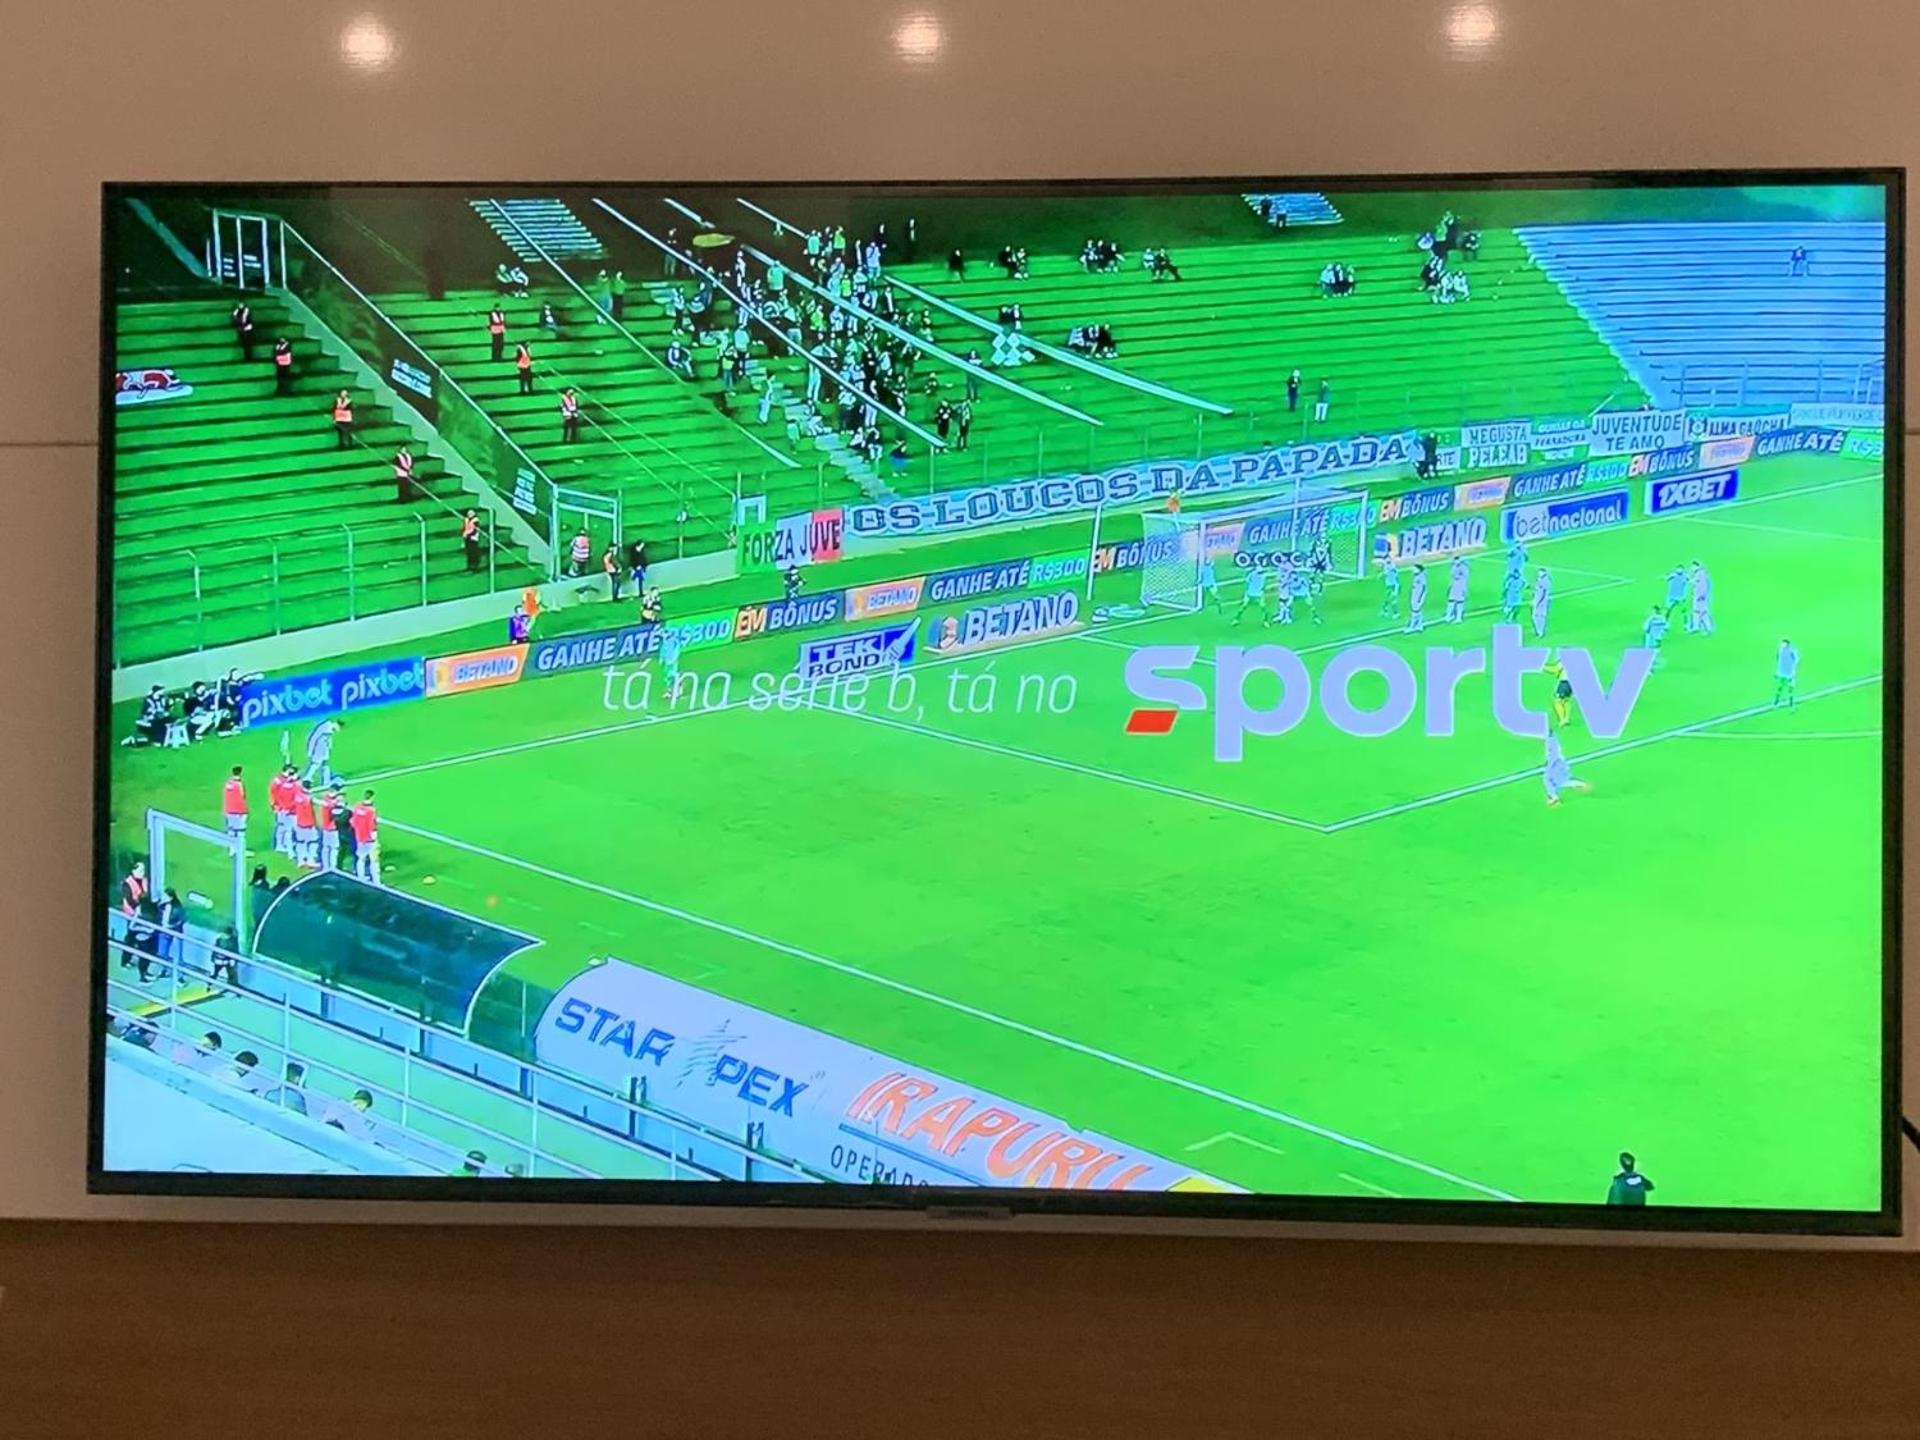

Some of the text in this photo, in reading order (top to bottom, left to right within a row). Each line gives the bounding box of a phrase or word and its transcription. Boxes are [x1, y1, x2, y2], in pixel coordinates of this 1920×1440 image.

[1592, 413, 1681, 436] JUVENTUDE
[1605, 436, 1665, 452] TE AMO
[1757, 433, 1801, 456] GANHE
[1803, 429, 1843, 452] ATÉ
[852, 438, 1407, 532] OS LOUCOS DA PAPADA
[1513, 475, 1560, 498] GANHE
[1560, 462, 1586, 488] ATÉ
[1649, 450, 1695, 474] BÔNUS
[1658, 473, 1732, 509] 1XBET
[1381, 498, 1402, 521] EM
[1401, 491, 1449, 518] BÔNUS
[1515, 498, 1622, 539] betnacional
[743, 518, 841, 565] FORZA JUVE
[1399, 517, 1487, 560] BETANO
[931, 571, 993, 601] GANHE
[994, 561, 1030, 589] ATÉ
[1034, 559, 1085, 581] R$300
[1116, 540, 1173, 569] BÔNUS
[537, 636, 618, 672] GANHE
[620, 626, 660, 658] ATÉ
[734, 606, 768, 638] EM
[768, 598, 837, 631] BÔNUS
[963, 590, 1079, 647] BETANO
[455, 655, 518, 684] BETANO
[808, 653, 881, 678] BOND
[812, 635, 879, 661] TEK
[242, 679, 334, 728] pixbet
[341, 662, 424, 711] pixbet
[603, 657, 651, 711] tá
[670, 671, 729, 711] na
[948, 657, 998, 713] tá
[1016, 672, 1078, 714] no
[1124, 623, 1656, 763] sportv
